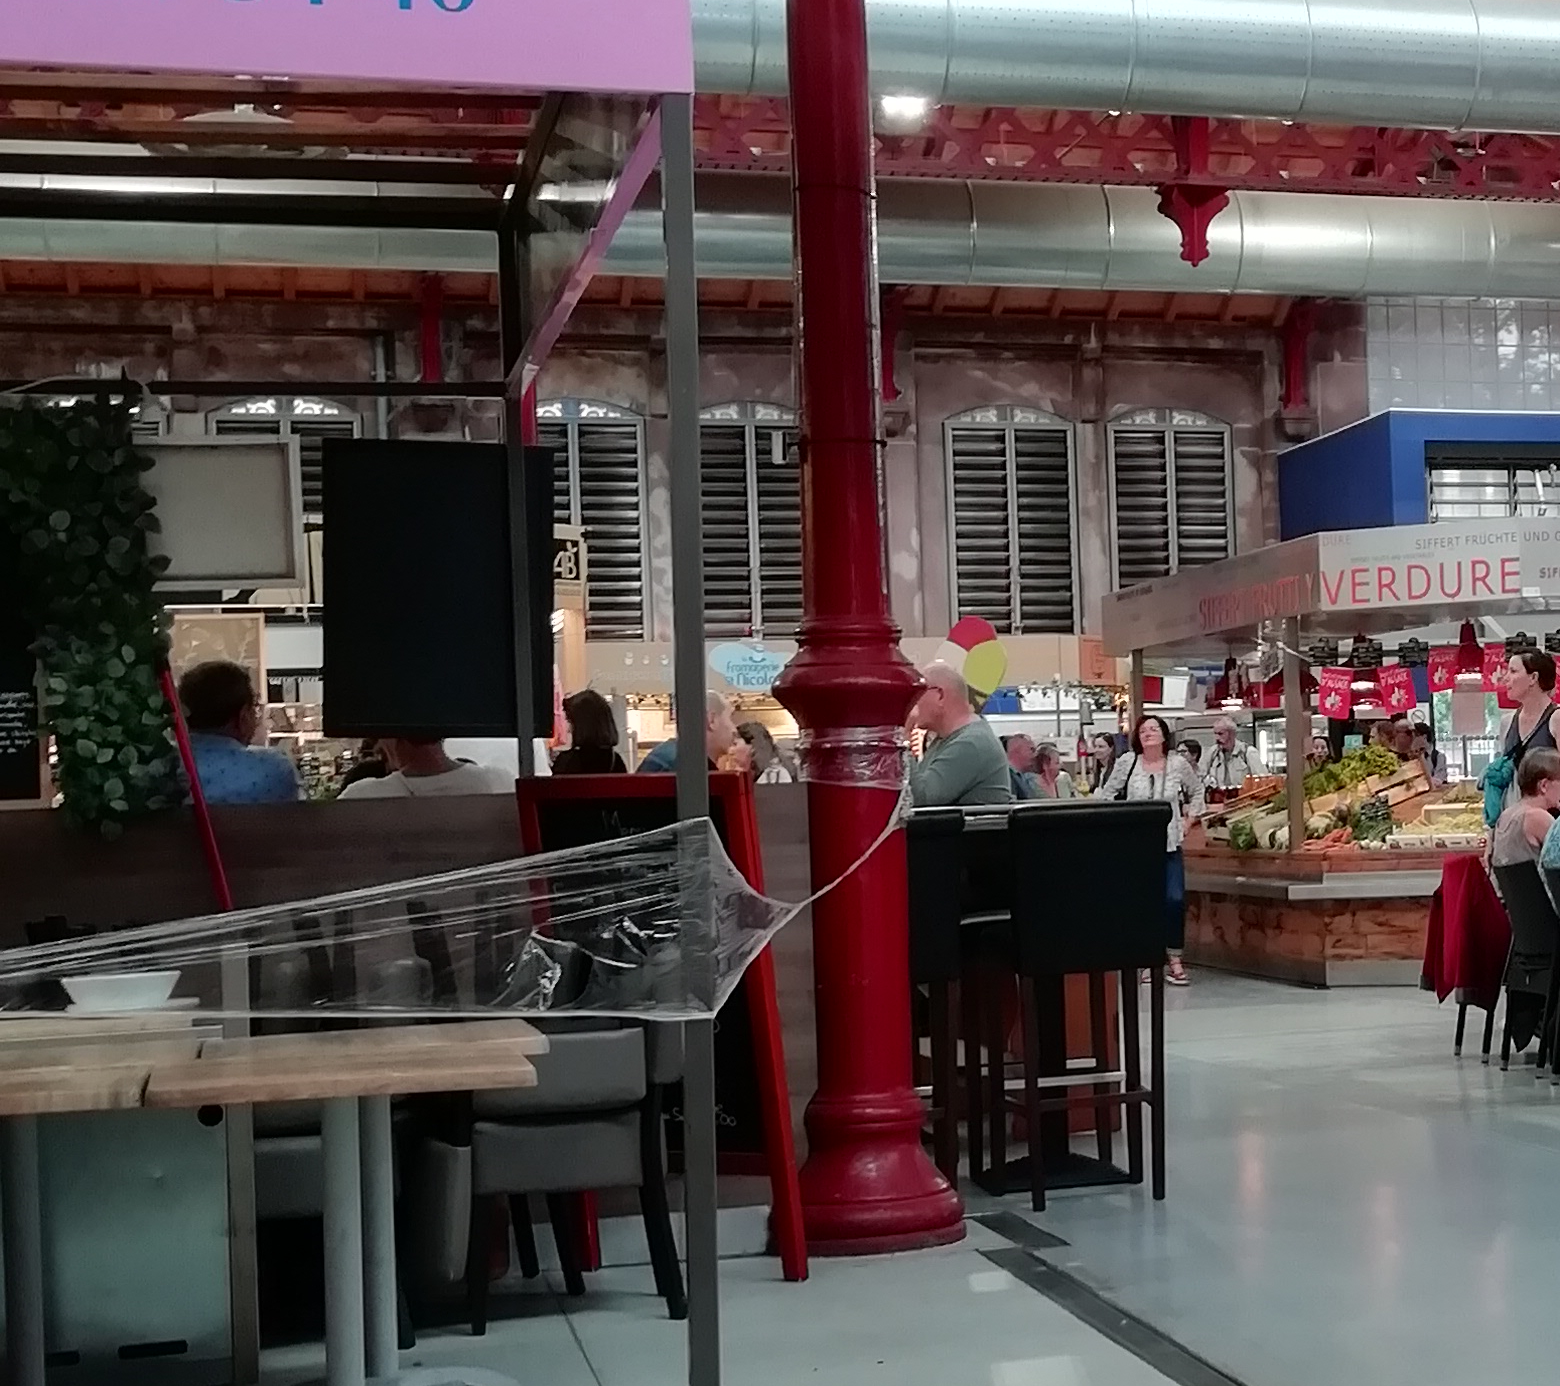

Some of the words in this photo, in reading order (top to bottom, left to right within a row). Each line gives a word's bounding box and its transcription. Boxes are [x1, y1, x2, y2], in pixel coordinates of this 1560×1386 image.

[1415, 536, 1461, 550] SIFFERT
[1465, 532, 1517, 546] FRUCHTE
[1523, 531, 1550, 542] UND
[1320, 557, 1521, 605] VERDURE
